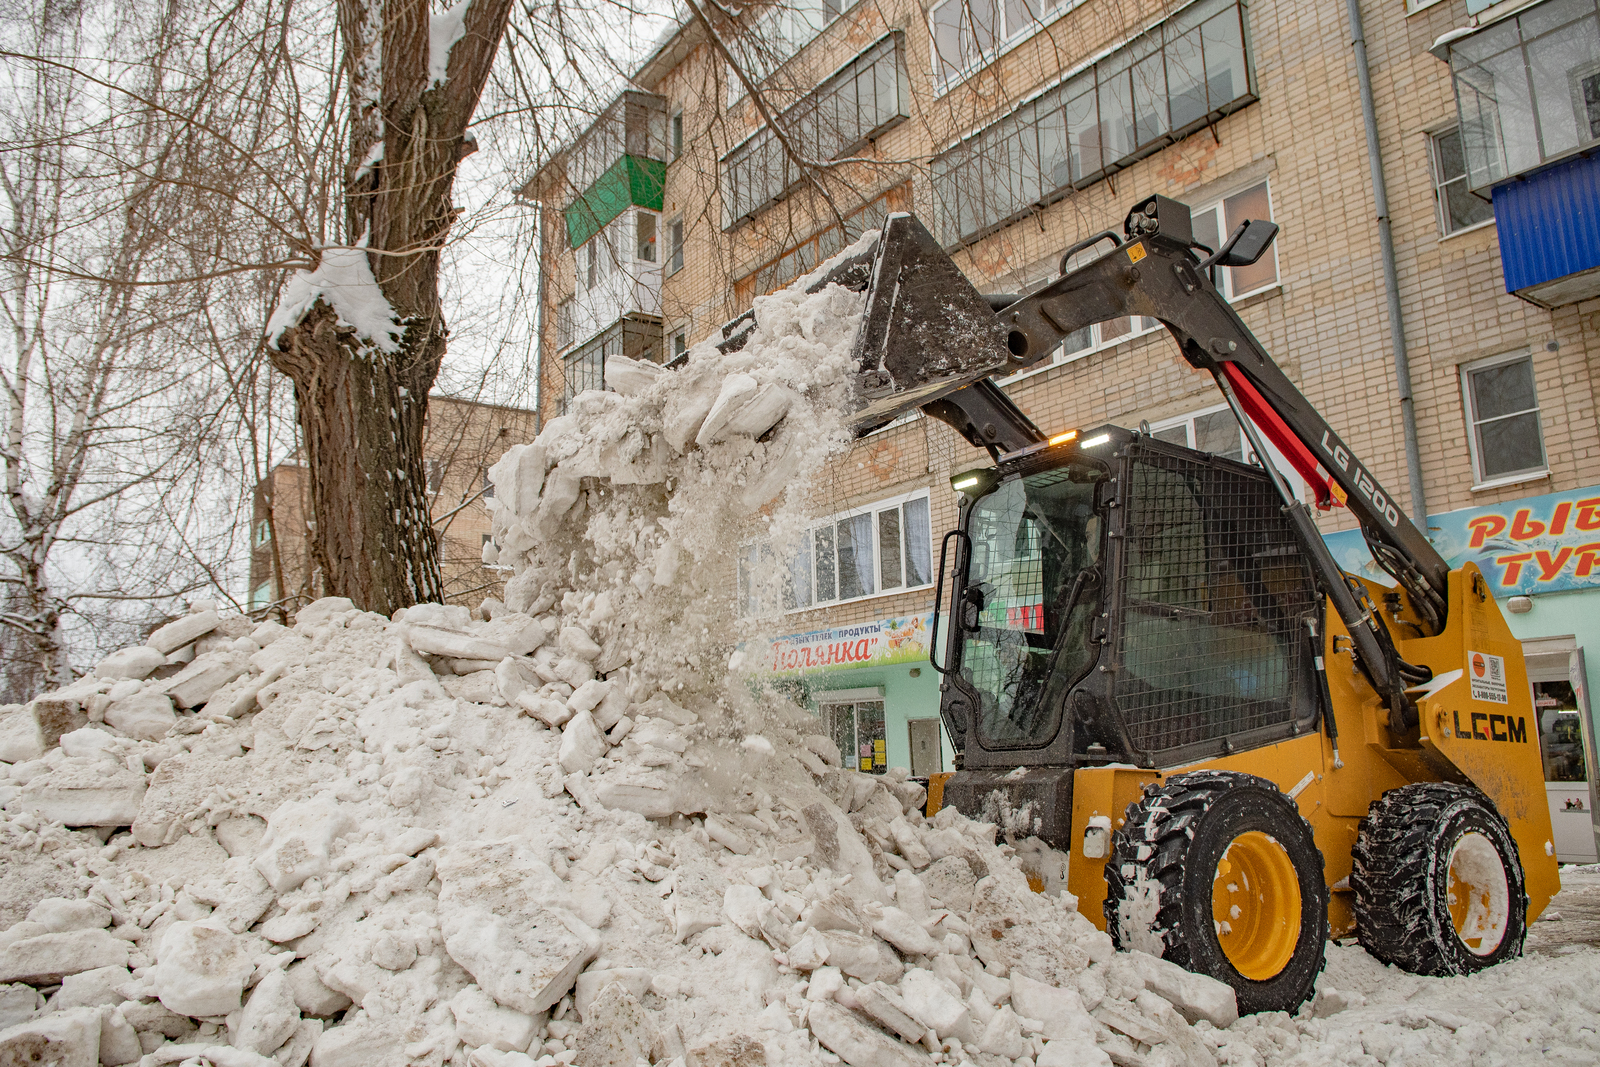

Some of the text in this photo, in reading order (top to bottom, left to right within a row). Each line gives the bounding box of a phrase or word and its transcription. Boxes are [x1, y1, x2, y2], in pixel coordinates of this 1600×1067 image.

[1321, 430, 1399, 527] LG 1200
[838, 624, 881, 638] ПРОДУКТЫ
